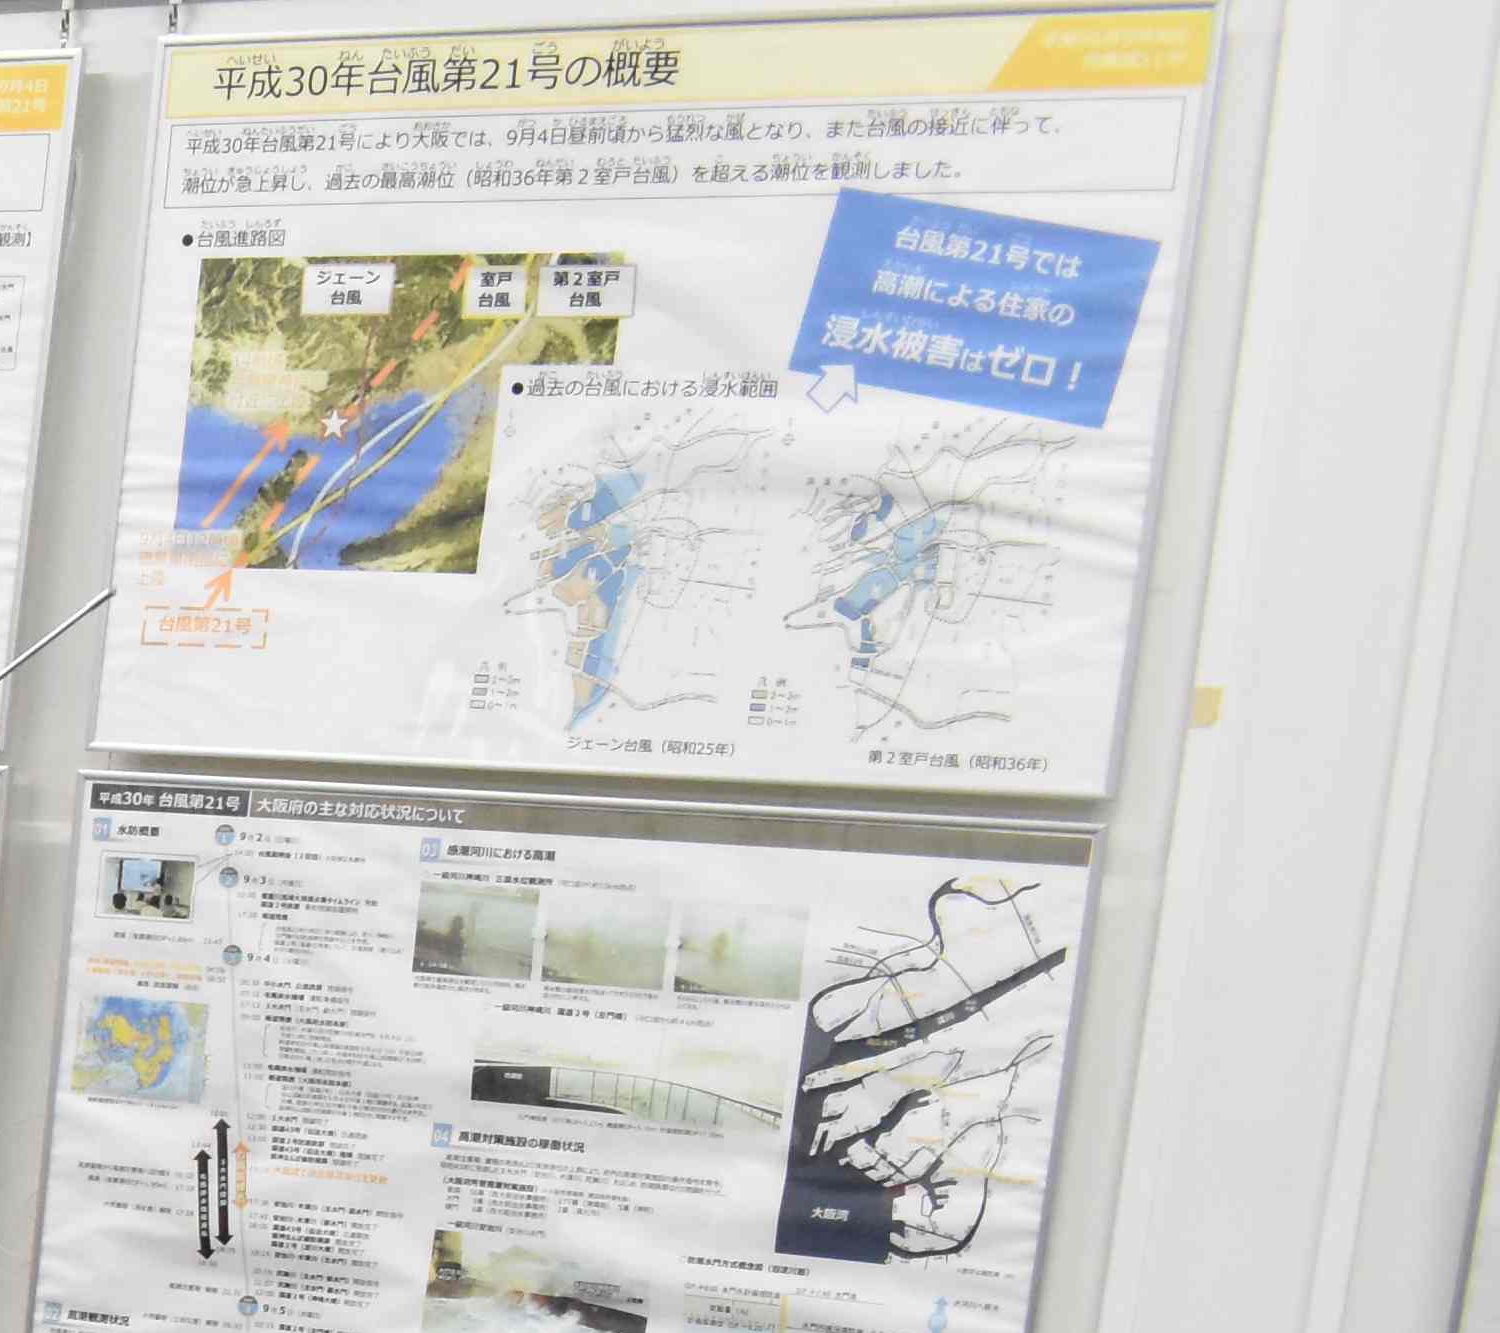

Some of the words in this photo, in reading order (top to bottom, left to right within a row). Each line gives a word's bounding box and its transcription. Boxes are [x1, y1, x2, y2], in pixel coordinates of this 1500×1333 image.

[213, 50, 680, 102] 平成30年台風第21号の概要
[196, 229, 286, 250] 台風進路図
[894, 226, 1083, 281] 台風第21号では
[315, 270, 381, 286] ジェーン
[480, 270, 514, 288] 室戸
[330, 288, 362, 306] 台風
[477, 290, 510, 308] 台風
[569, 291, 602, 308] 台風
[871, 269, 1076, 328] 高潮による住家の
[527, 376, 779, 400] 過去の台風における浸水範囲
[566, 735, 736, 758] ジェーン台風（昭和25年）
[98, 789, 156, 808] 平成30年
[157, 793, 242, 812] 台風第21号
[256, 797, 466, 825] 大阪府の主な対応状況について
